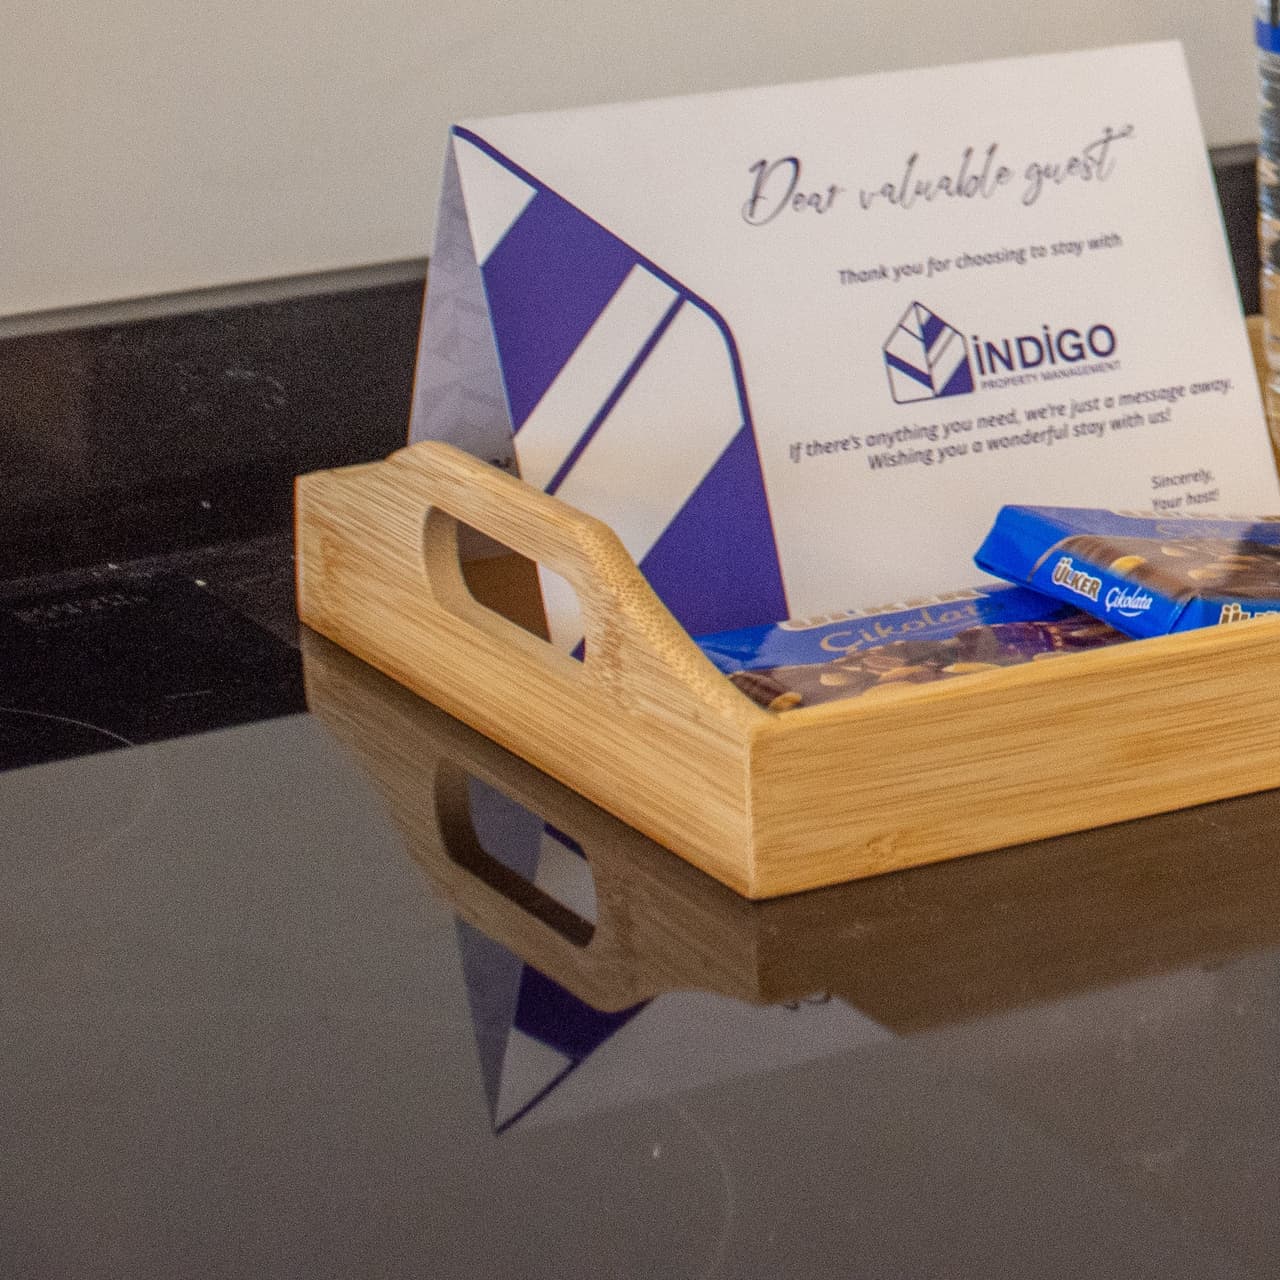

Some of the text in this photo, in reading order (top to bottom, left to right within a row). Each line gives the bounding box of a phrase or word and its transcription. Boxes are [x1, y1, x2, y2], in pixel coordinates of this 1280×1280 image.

[741, 124, 1136, 226] Dear valuable guest
[838, 233, 1123, 285] Thank you for choosing to stay with
[981, 360, 1121, 389] PROPERTY MANAGEMENT
[790, 441, 802, 463] If
[805, 434, 862, 457] there's
[865, 422, 939, 449] anything
[942, 420, 973, 440] you
[1024, 403, 1067, 422] we're
[1070, 398, 1101, 419] just
[1103, 397, 1116, 409] a
[1118, 386, 1187, 406] message
[1189, 378, 1235, 396] away.
[867, 408, 1172, 471] Wishing you a wonderful stay with us!
[1151, 470, 1216, 491] Sincerely,
[1152, 499, 1184, 512] Your
[1053, 558, 1153, 613] ÜLKER Çikolata
